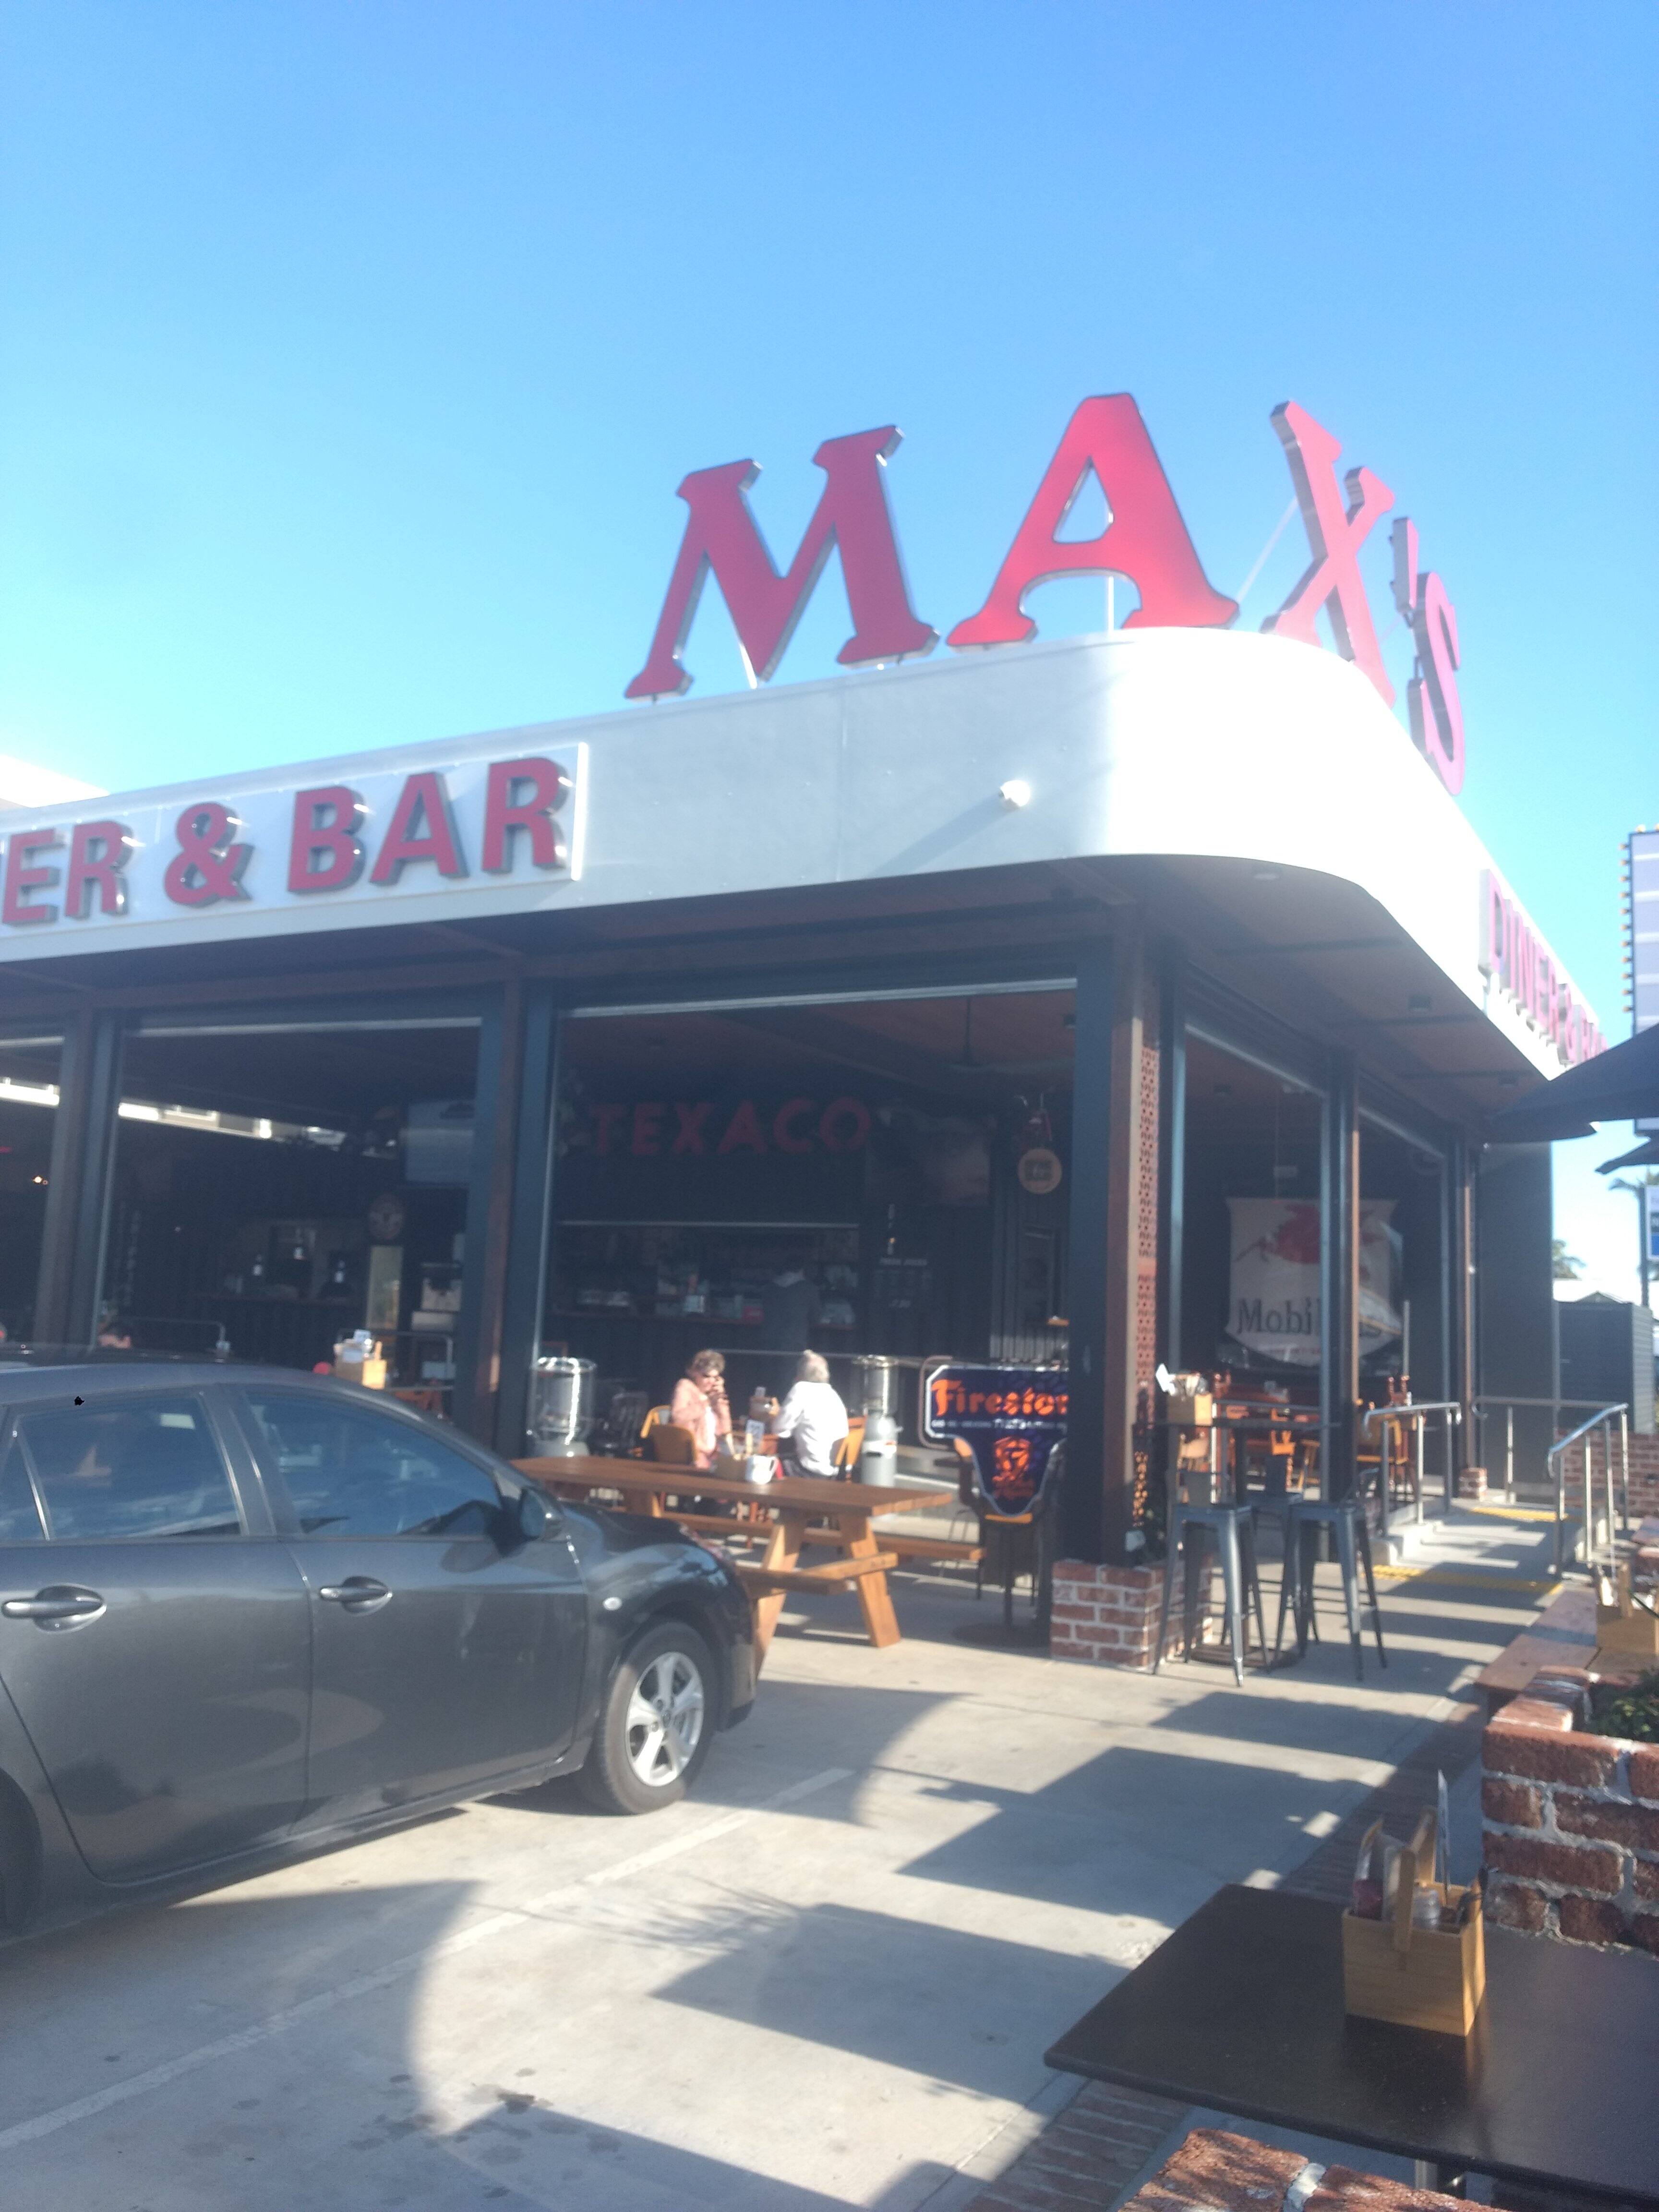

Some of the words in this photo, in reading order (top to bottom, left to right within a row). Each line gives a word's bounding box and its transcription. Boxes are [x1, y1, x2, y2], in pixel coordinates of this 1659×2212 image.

[624, 392, 1466, 796] MAX'S
[164, 801, 254, 909] &
[287, 757, 571, 895] BAR
[1478, 869, 1559, 1046] DINER
[588, 1096, 872, 1155] TEXACO
[1237, 1297, 1321, 1336] Mobi
